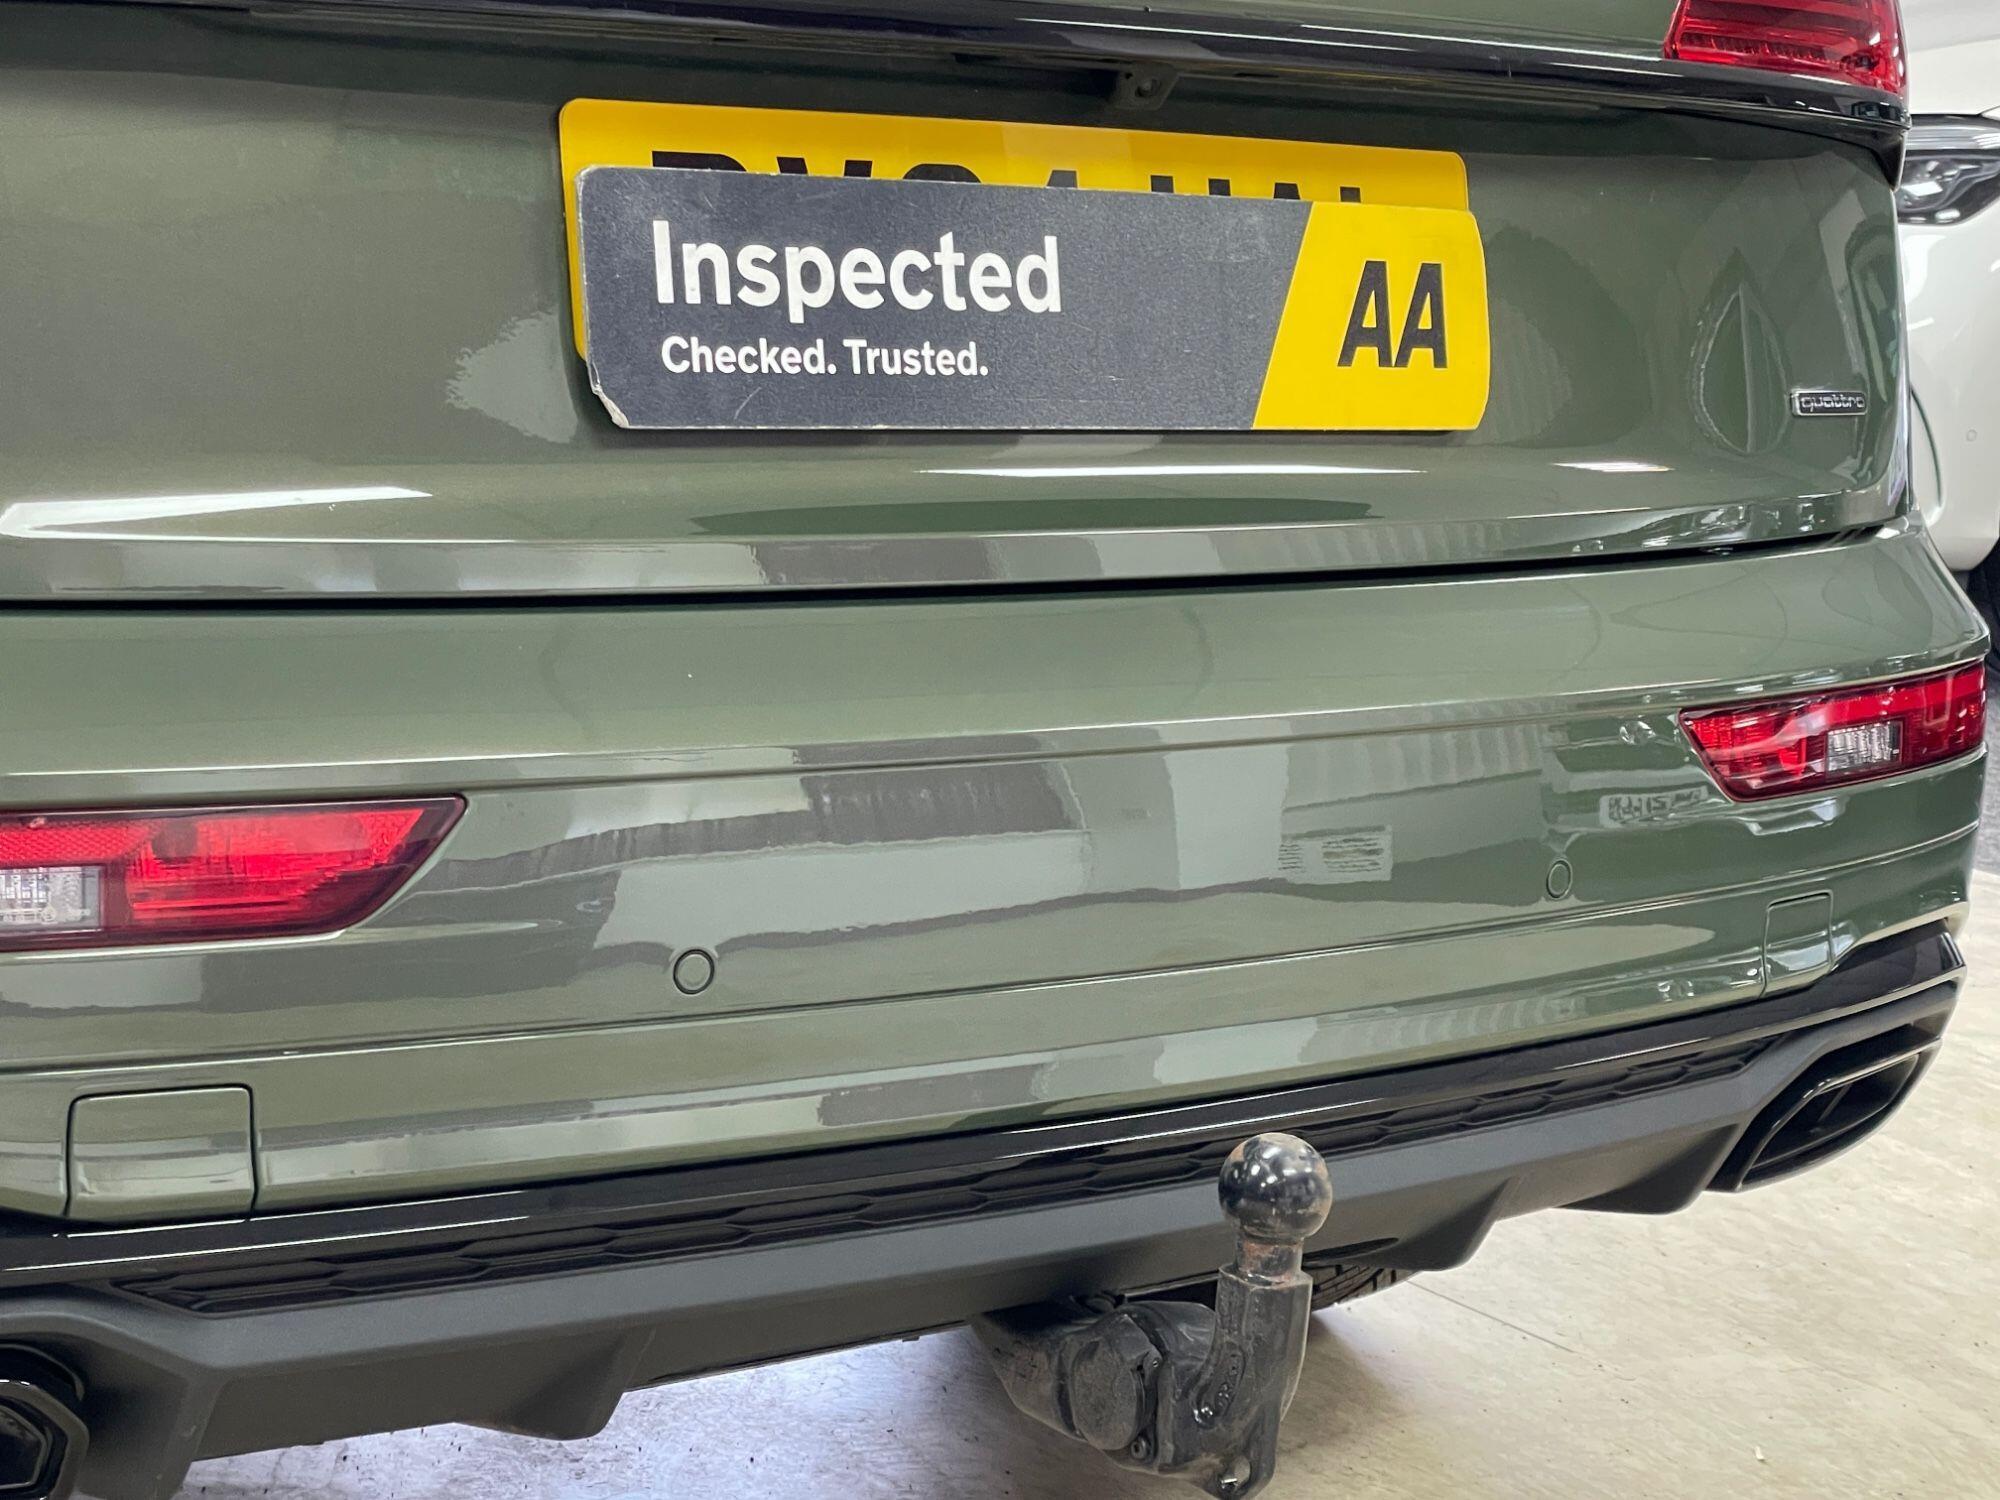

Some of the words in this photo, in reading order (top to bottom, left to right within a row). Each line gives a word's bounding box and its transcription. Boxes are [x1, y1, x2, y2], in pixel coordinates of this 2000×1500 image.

[652, 220, 1062, 323] Inspected
[1337, 260, 1448, 369] AA
[661, 336, 837, 375] Checked.
[843, 338, 989, 377] Trusted.
[1800, 394, 1865, 412] quattro
